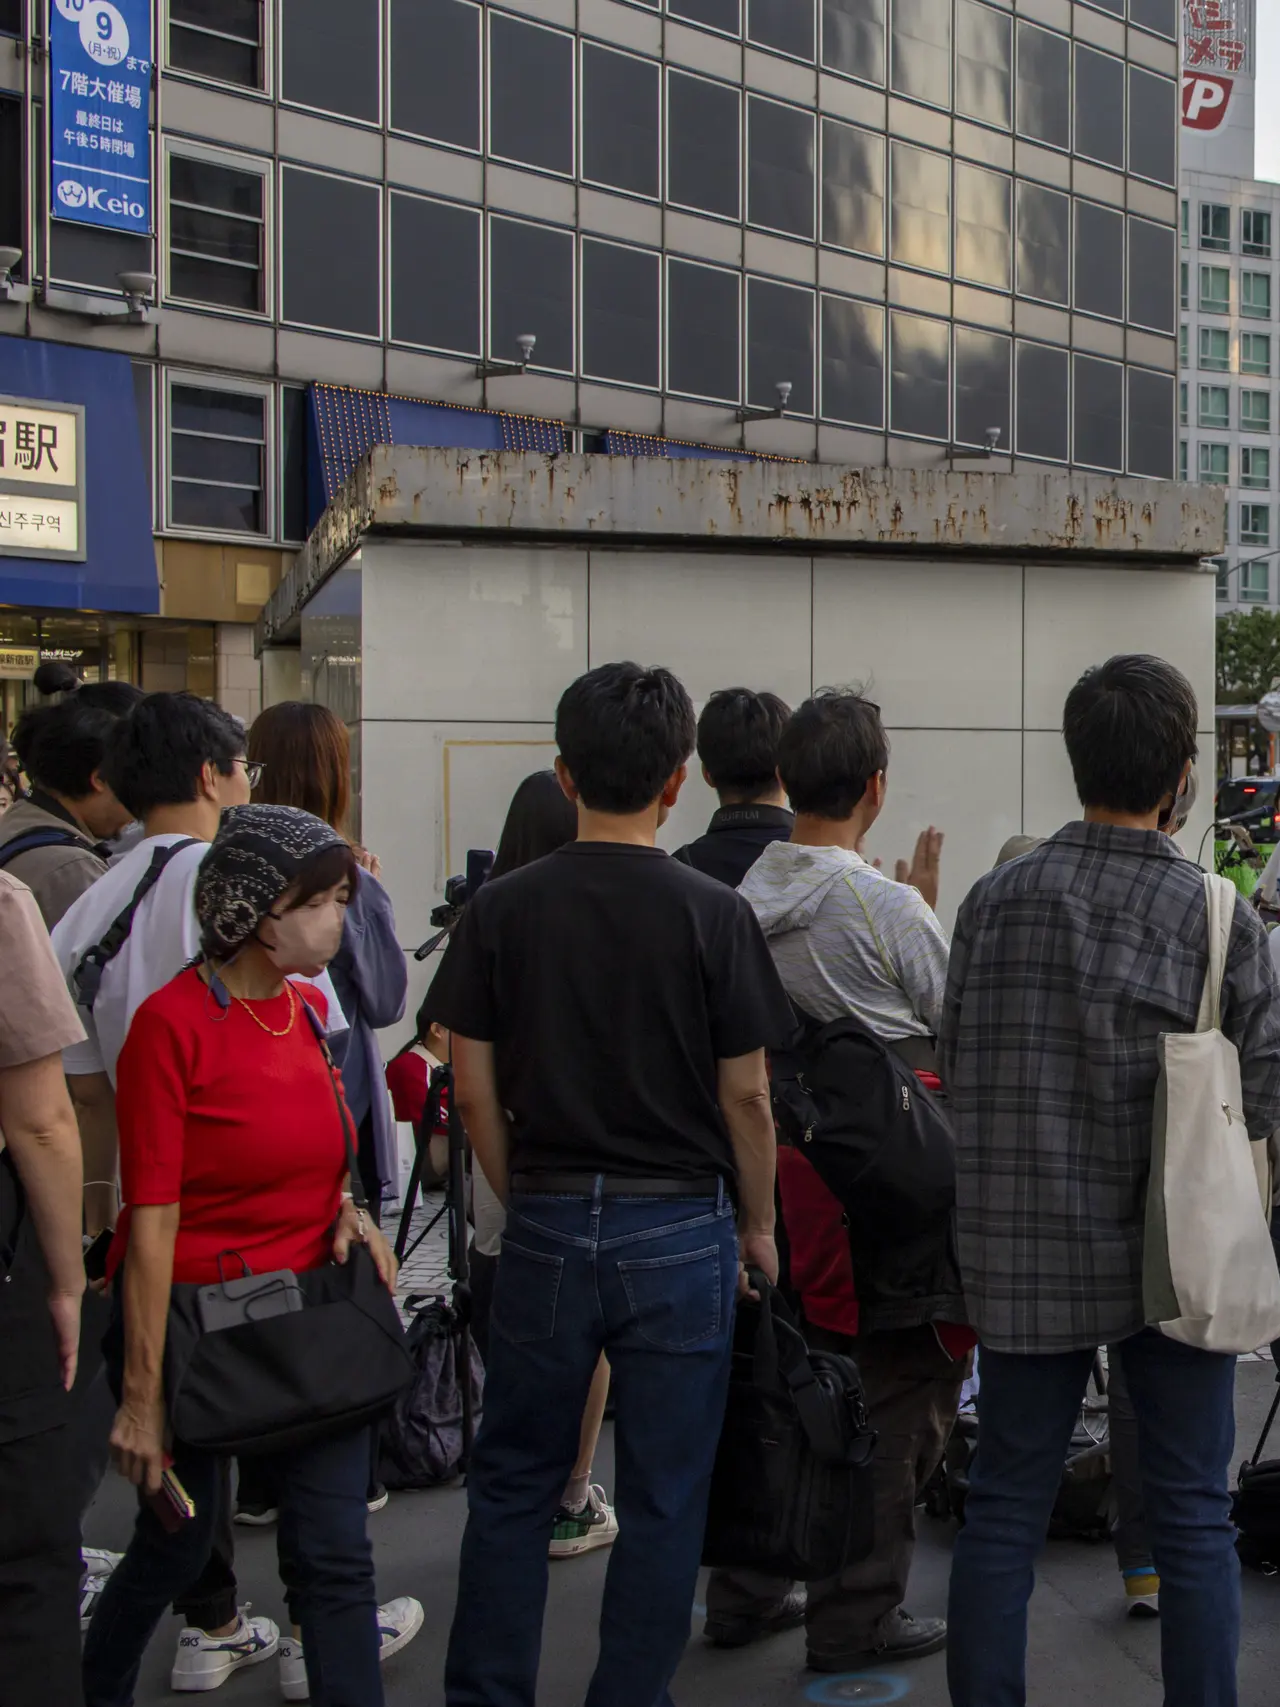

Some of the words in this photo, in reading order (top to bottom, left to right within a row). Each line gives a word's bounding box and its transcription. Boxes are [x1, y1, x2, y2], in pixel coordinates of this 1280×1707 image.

[96, 11, 113, 40] 9
[126, 55, 149, 74] まで
[59, 69, 142, 109] 7階大催場
[75, 109, 124, 134] 最終日は
[63, 129, 136, 159] 午後5時閉場
[87, 186, 145, 219] Keio
[0, 420, 59, 473] 駅
